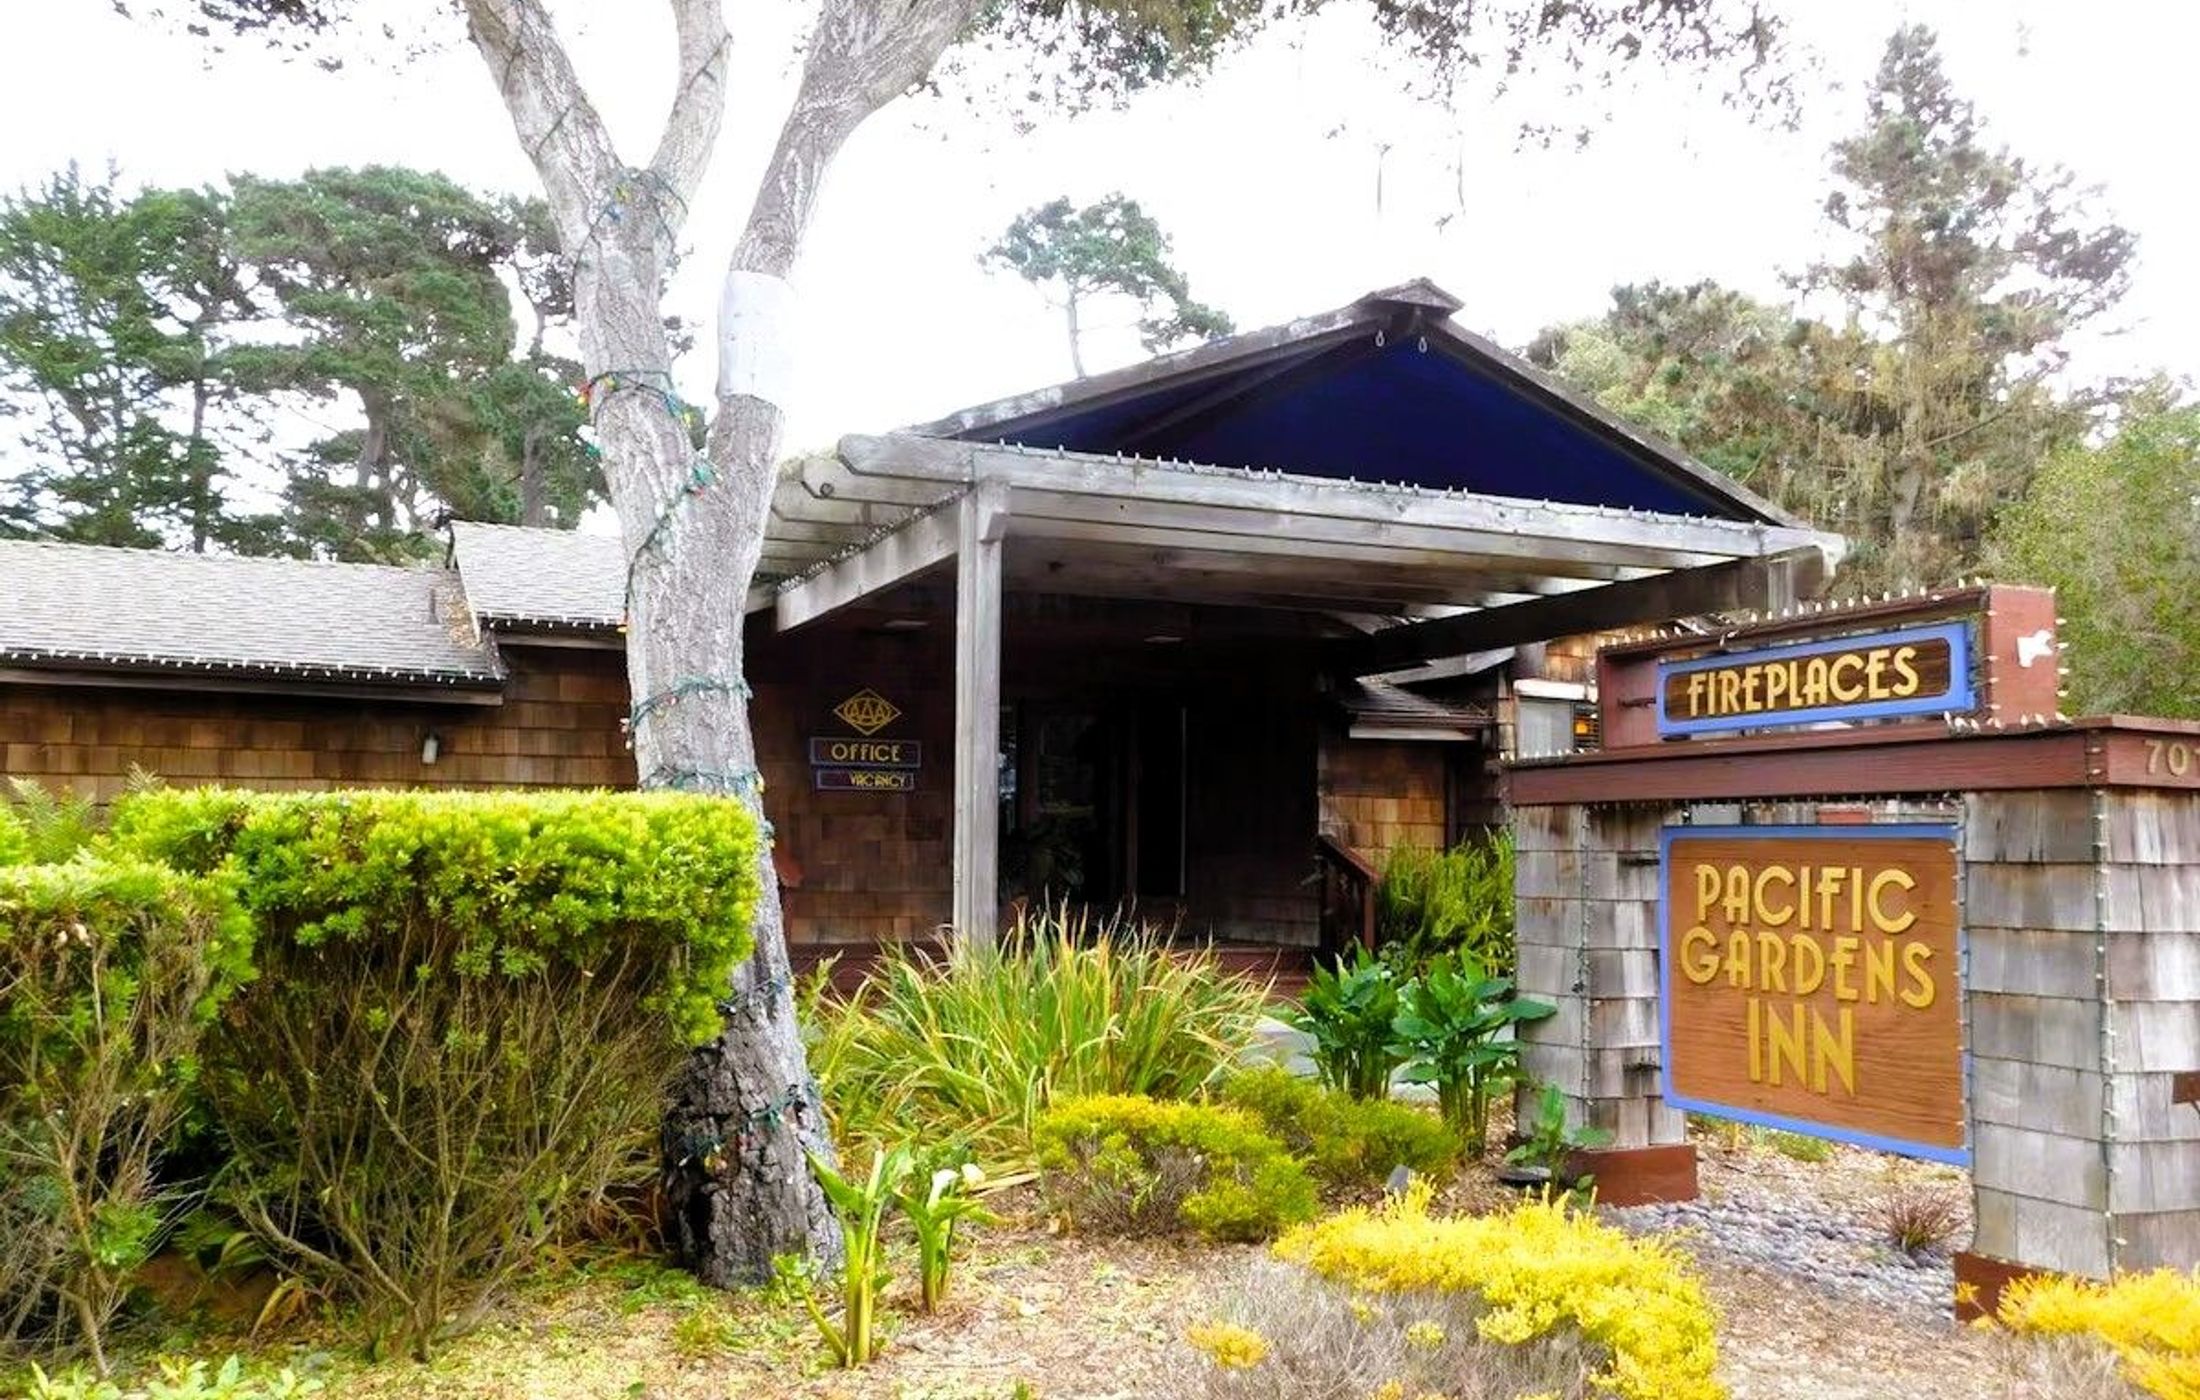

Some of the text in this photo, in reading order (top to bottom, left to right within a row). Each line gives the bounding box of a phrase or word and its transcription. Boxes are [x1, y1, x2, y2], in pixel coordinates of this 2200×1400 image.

[1687, 646, 1919, 717] FIREPLACES
[845, 699, 891, 725] AAA
[831, 743, 901, 762] OFFICE
[2144, 740, 2200, 776] 70
[850, 772, 905, 787] VACANCY
[1694, 863, 1917, 935] PACIFIC
[1680, 926, 1936, 1009] GARDENS
[1748, 998, 1856, 1096] INN
